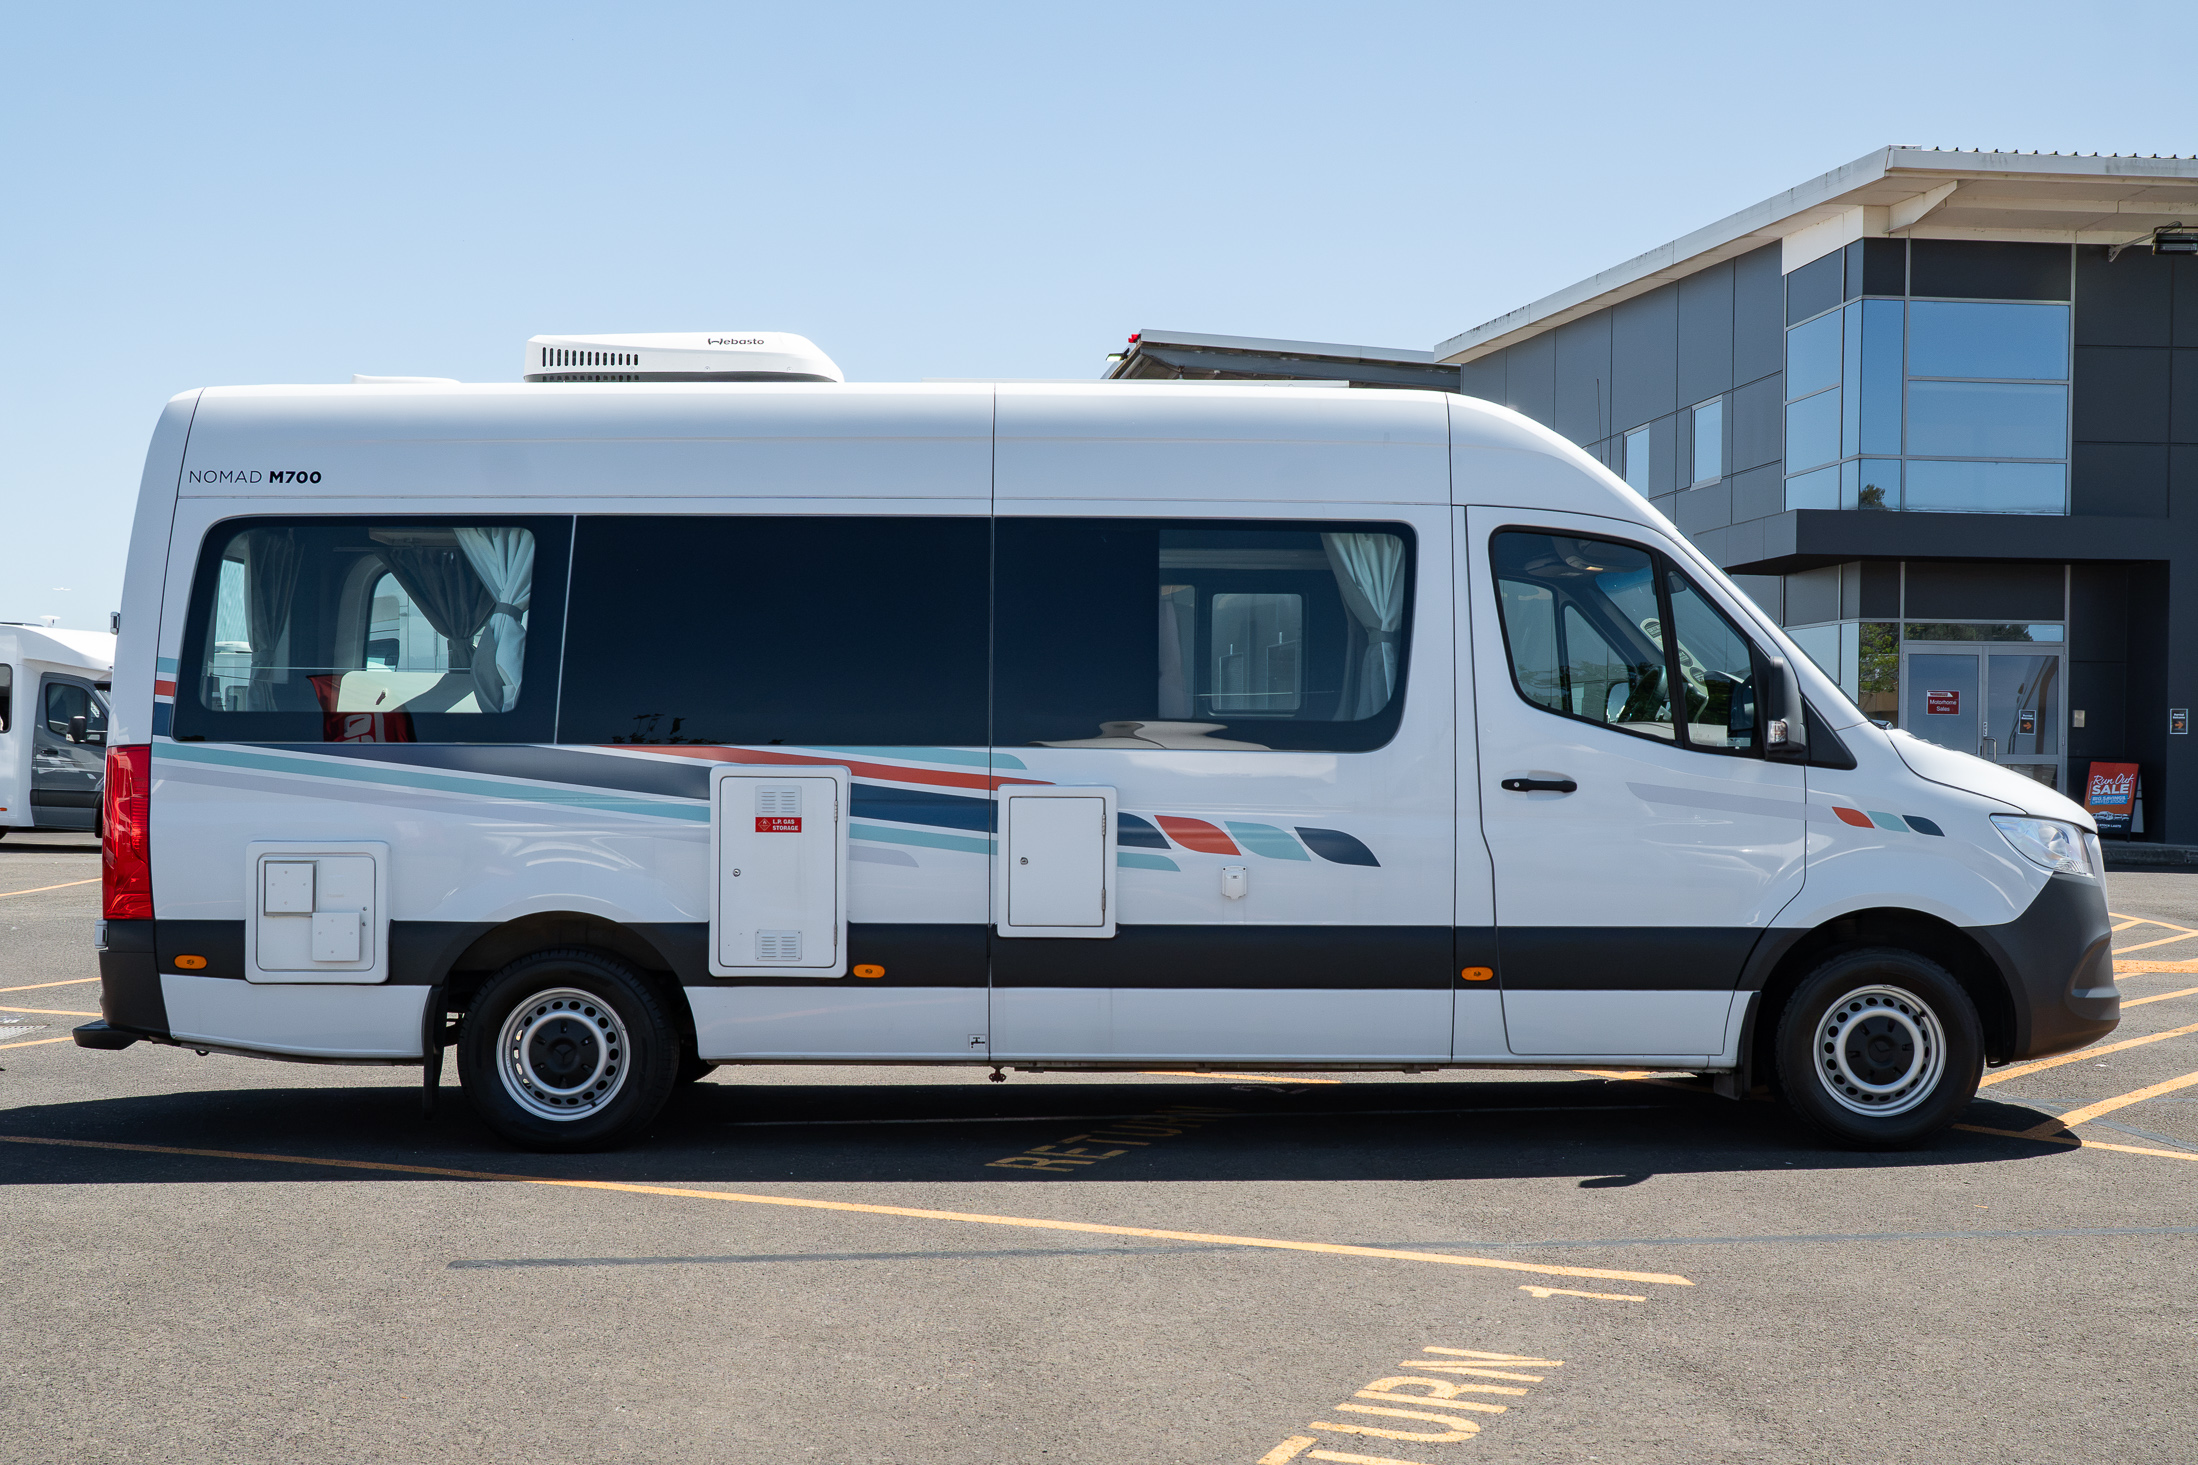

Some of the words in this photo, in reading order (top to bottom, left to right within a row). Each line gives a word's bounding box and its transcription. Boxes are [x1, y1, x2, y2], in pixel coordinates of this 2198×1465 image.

[189, 470, 262, 484] NOMAD
[269, 471, 322, 484] M700
[2093, 775, 2114, 786] Run
[2115, 773, 2134, 785] Out
[2092, 784, 2129, 794] SALE
[984, 1105, 1246, 1172] RETURN
[1519, 1284, 1646, 1302] 1
